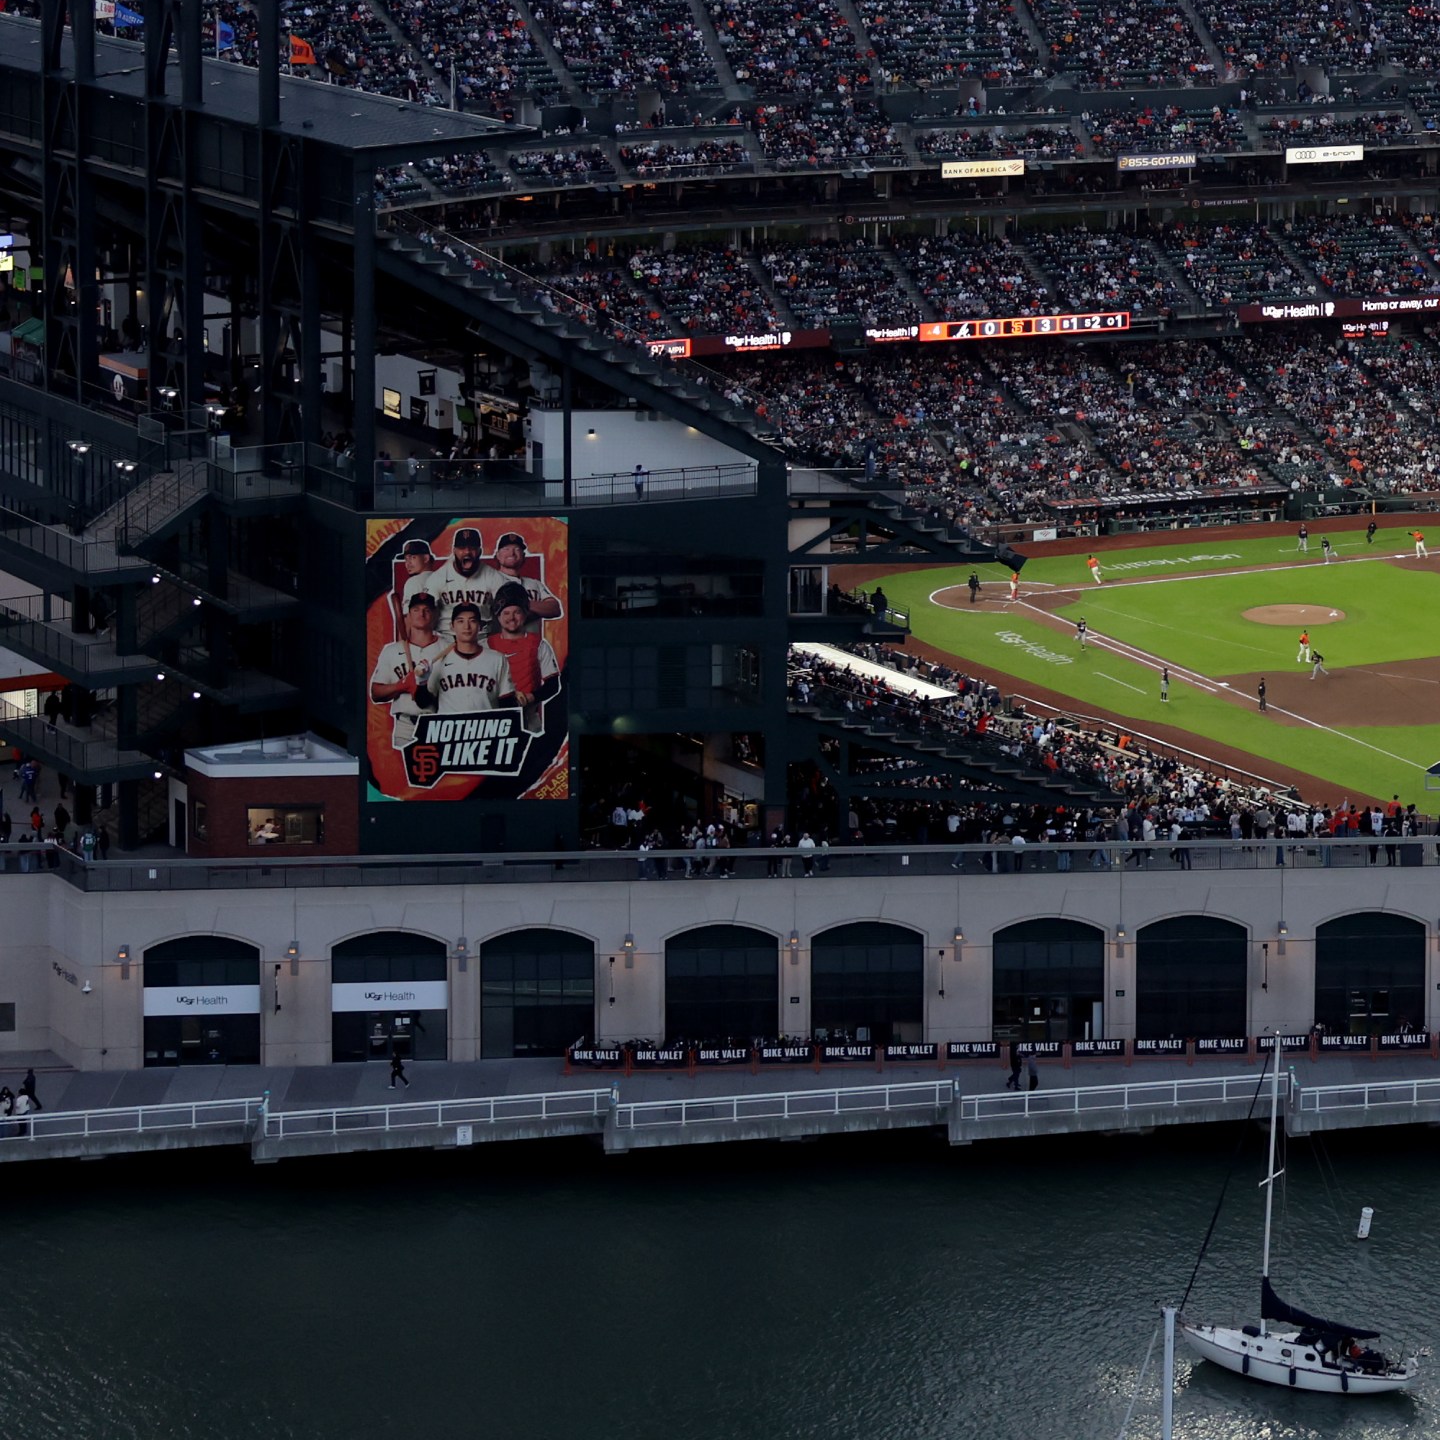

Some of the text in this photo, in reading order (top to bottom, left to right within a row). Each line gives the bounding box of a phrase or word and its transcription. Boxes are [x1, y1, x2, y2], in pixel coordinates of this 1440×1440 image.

[1362, 300, 1388, 311] Home
[1389, 301, 1398, 310] or
[1400, 299, 1423, 310] away,
[1424, 298, 1438, 308] our
[1284, 305, 1319, 318] Health
[932, 326, 940, 335] 4
[985, 323, 994, 334] 0
[1041, 320, 1050, 331] 3
[1357, 323, 1379, 331] Helth
[882, 327, 907, 338] Health
[744, 333, 777, 346] Health
[442, 589, 493, 606] GIANTS
[440, 673, 496, 692] GIANTS
[425, 719, 512, 744] NOTHING
[440, 737, 518, 766] LIKE IT
[412, 745, 440, 782] SF
[535, 768, 569, 799] SPLASH
[550, 781, 569, 799] HITS
[176, 995, 228, 1005] UCSF Health
[364, 991, 416, 1001] UCSF Health
[1137, 1039, 1182, 1049] BIKE VALET
[1199, 1038, 1244, 1048] BIKE VALET
[1260, 1036, 1305, 1047] BIK VALET
[1322, 1036, 1367, 1046] BIKE VALET
[1381, 1034, 1426, 1044] BIKE VALET
[826, 1046, 872, 1057] BIKE VALET
[888, 1045, 934, 1055] BIKE VALET
[951, 1043, 997, 1053] BIKE VALET
[1018, 1042, 1059, 1052] IKE VALET
[1075, 1041, 1120, 1051] BIKE VALET
[574, 1050, 619, 1060] BIKE VALET
[637, 1050, 684, 1060] BIKE VALET
[700, 1049, 746, 1060] BIKE VALET
[762, 1047, 808, 1058] BIKE VALET
